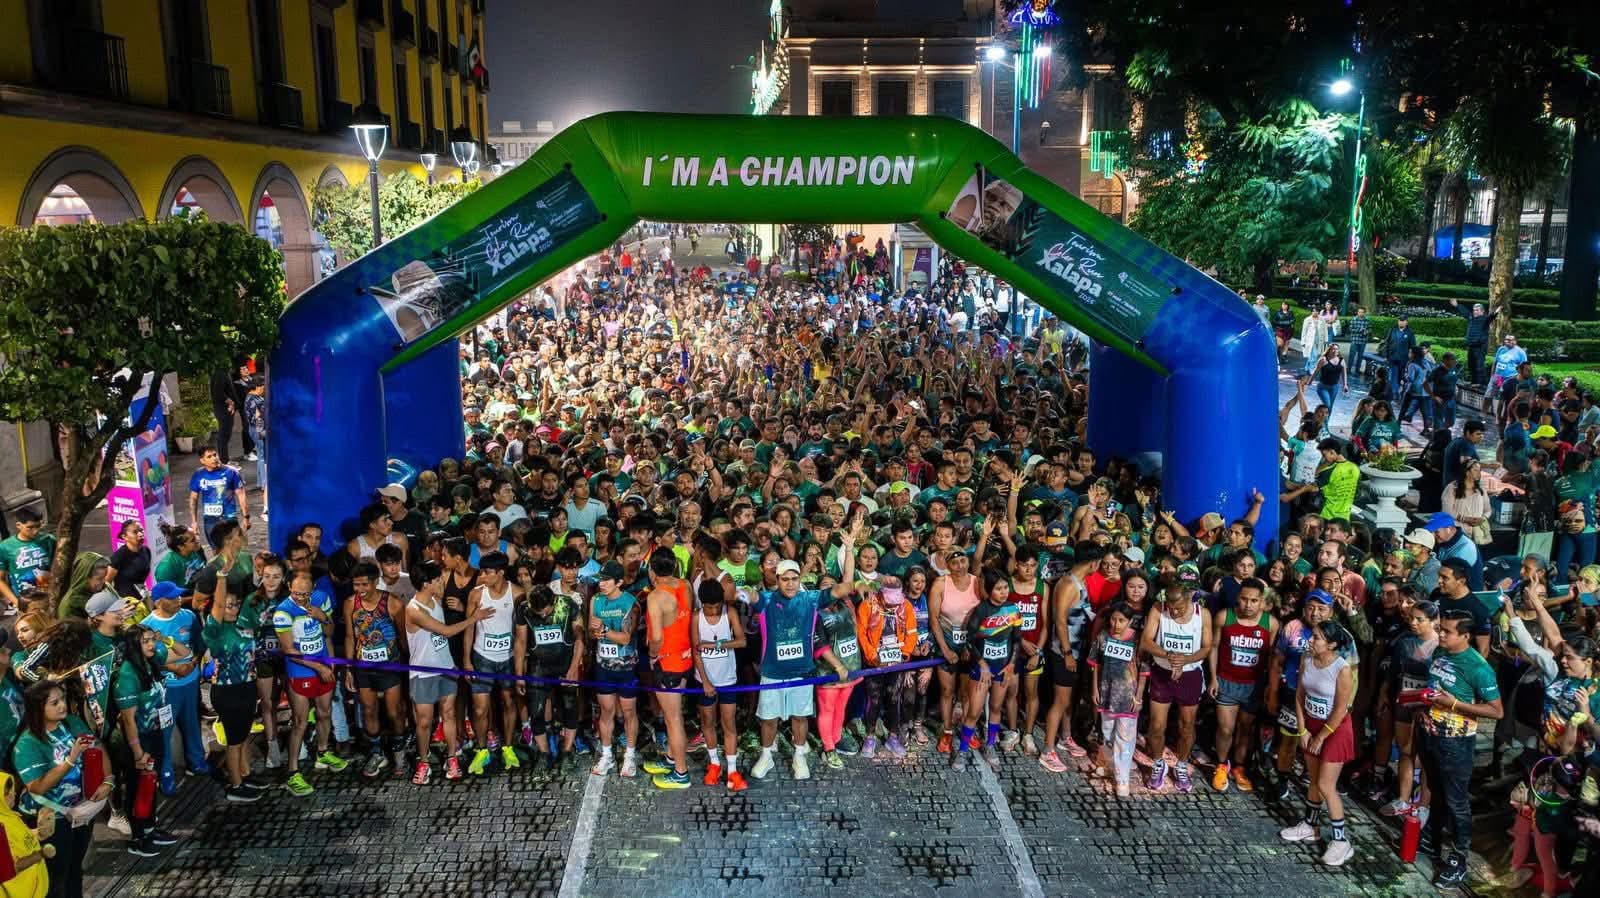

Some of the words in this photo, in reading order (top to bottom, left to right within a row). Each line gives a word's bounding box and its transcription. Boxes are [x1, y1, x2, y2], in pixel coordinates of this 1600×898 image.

[708, 156, 729, 186] A
[739, 155, 915, 187] CHAMPION
[485, 226, 551, 277] Xalapa
[1035, 248, 1103, 298] Xalapa
[537, 631, 562, 642] 1397
[1230, 633, 1264, 649] MÉXICO
[486, 639, 510, 649] 0755
[1165, 640, 1192, 651] 0814
[778, 646, 802, 657] 0490
[1107, 644, 1132, 658] 0578
[1233, 655, 1258, 664] 1226
